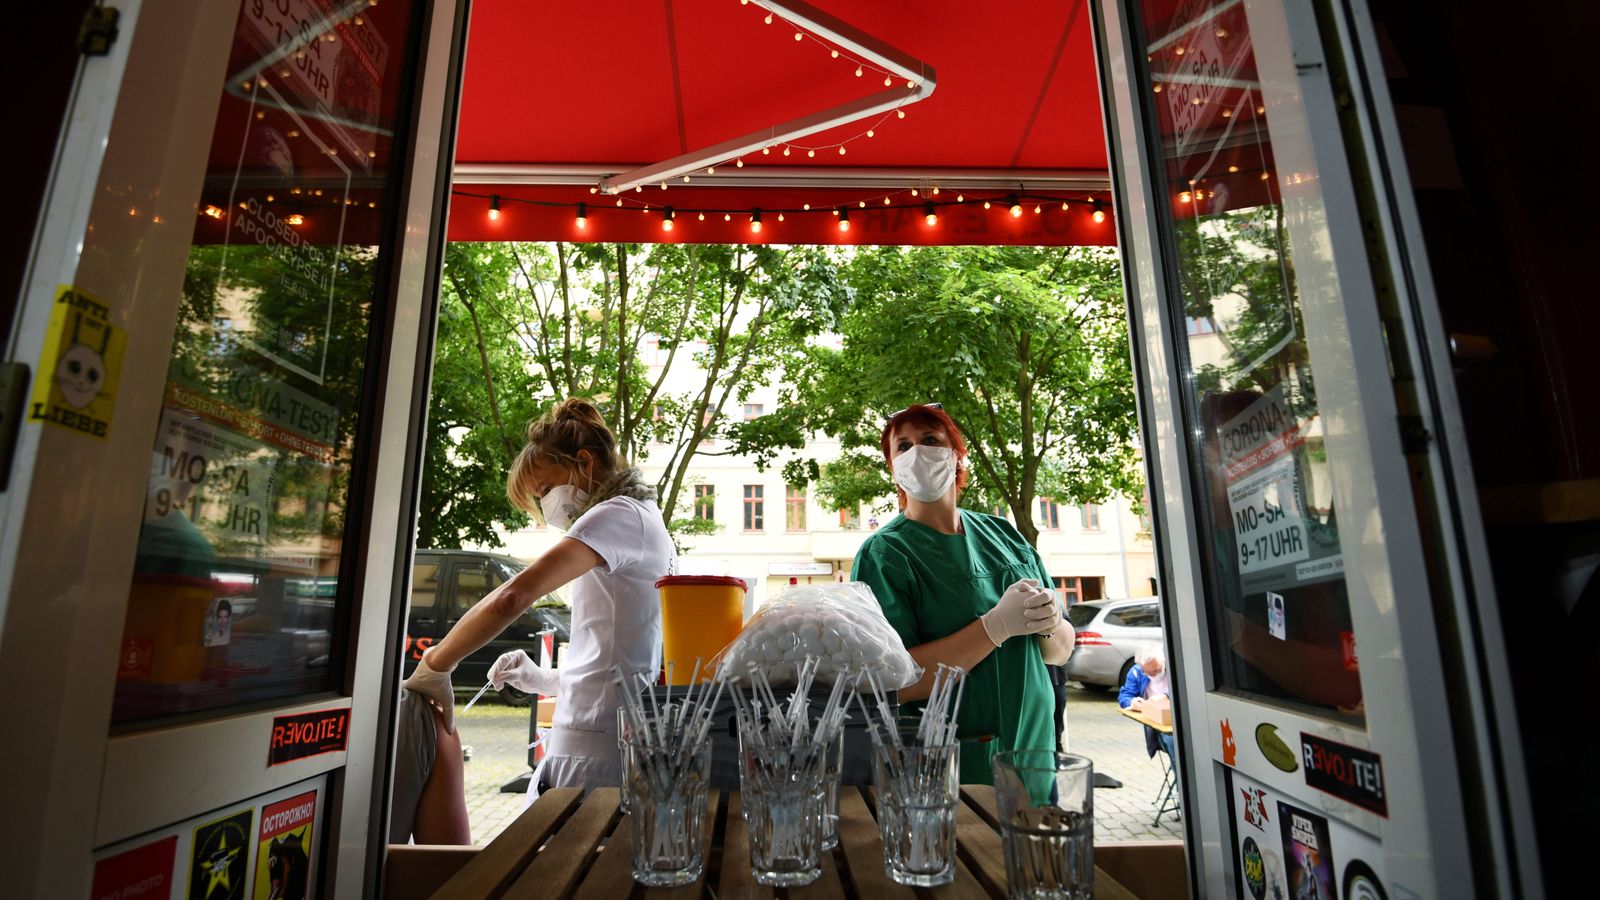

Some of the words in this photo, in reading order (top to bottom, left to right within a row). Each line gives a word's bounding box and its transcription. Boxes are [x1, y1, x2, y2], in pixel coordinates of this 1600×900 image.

[296, 48, 330, 99] UHR
[248, 198, 299, 248] CLOSED
[234, 213, 319, 285] APOCALYPSE
[32, 403, 108, 438] LIEBE
[1235, 500, 1285, 535] MO-SA
[1241, 534, 1269, 565] 9-17
[1269, 525, 1303, 558] UHR
